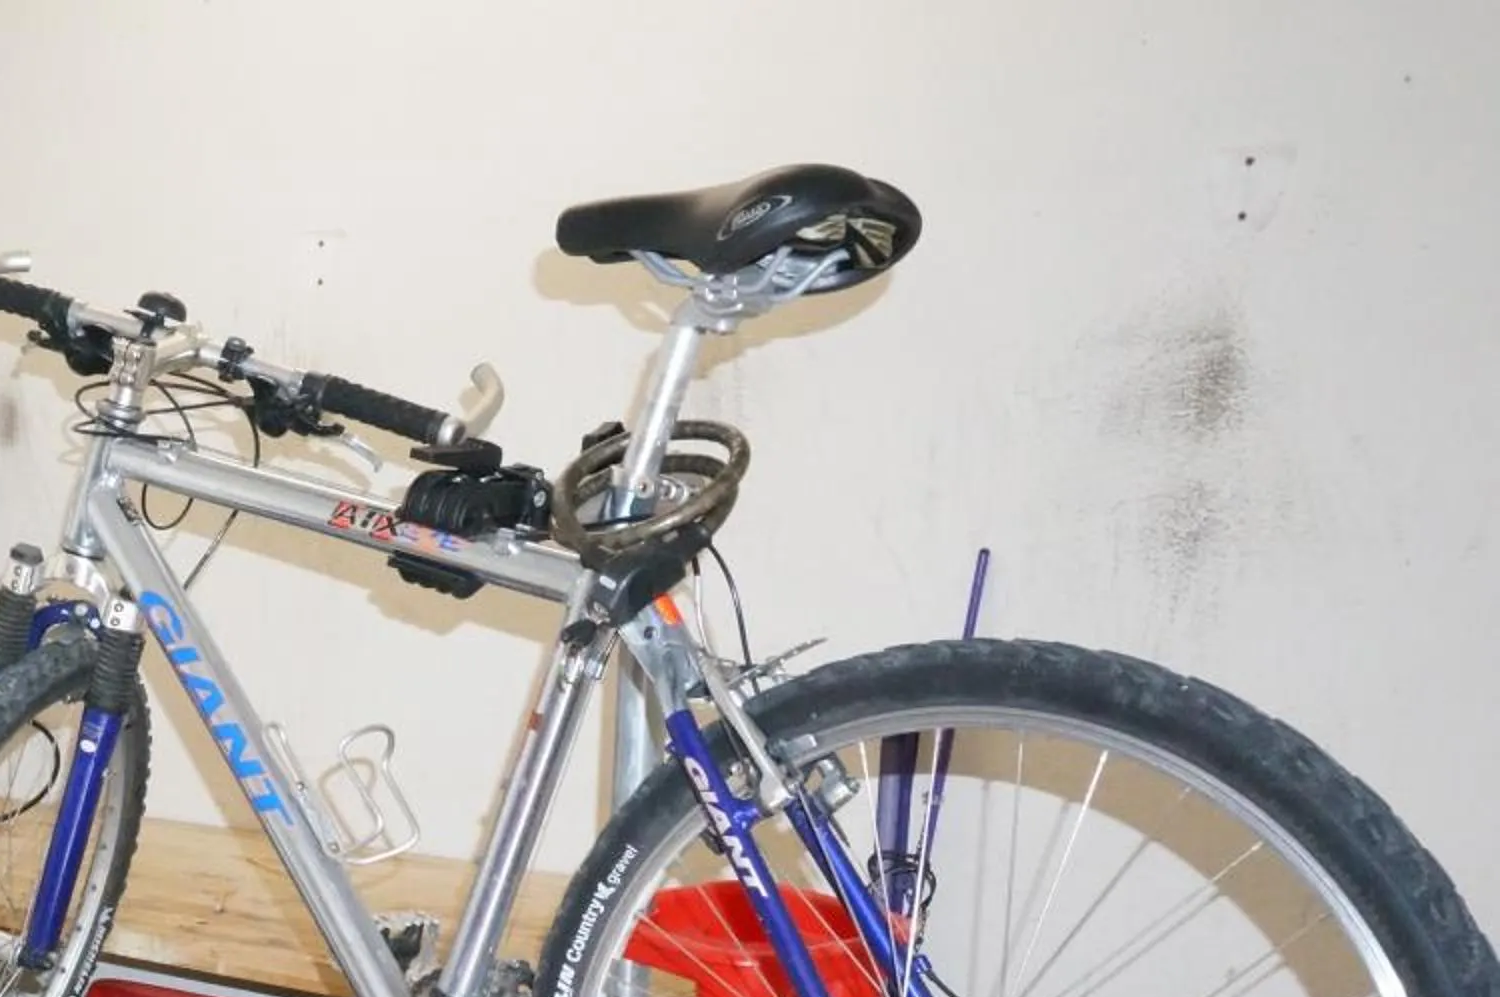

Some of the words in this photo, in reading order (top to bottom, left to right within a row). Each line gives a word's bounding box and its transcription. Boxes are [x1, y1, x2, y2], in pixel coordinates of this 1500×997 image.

[139, 590, 295, 827] GIANT
[684, 756, 769, 898] GIANT
[565, 901, 606, 964] Country
[606, 843, 639, 885] gravel
